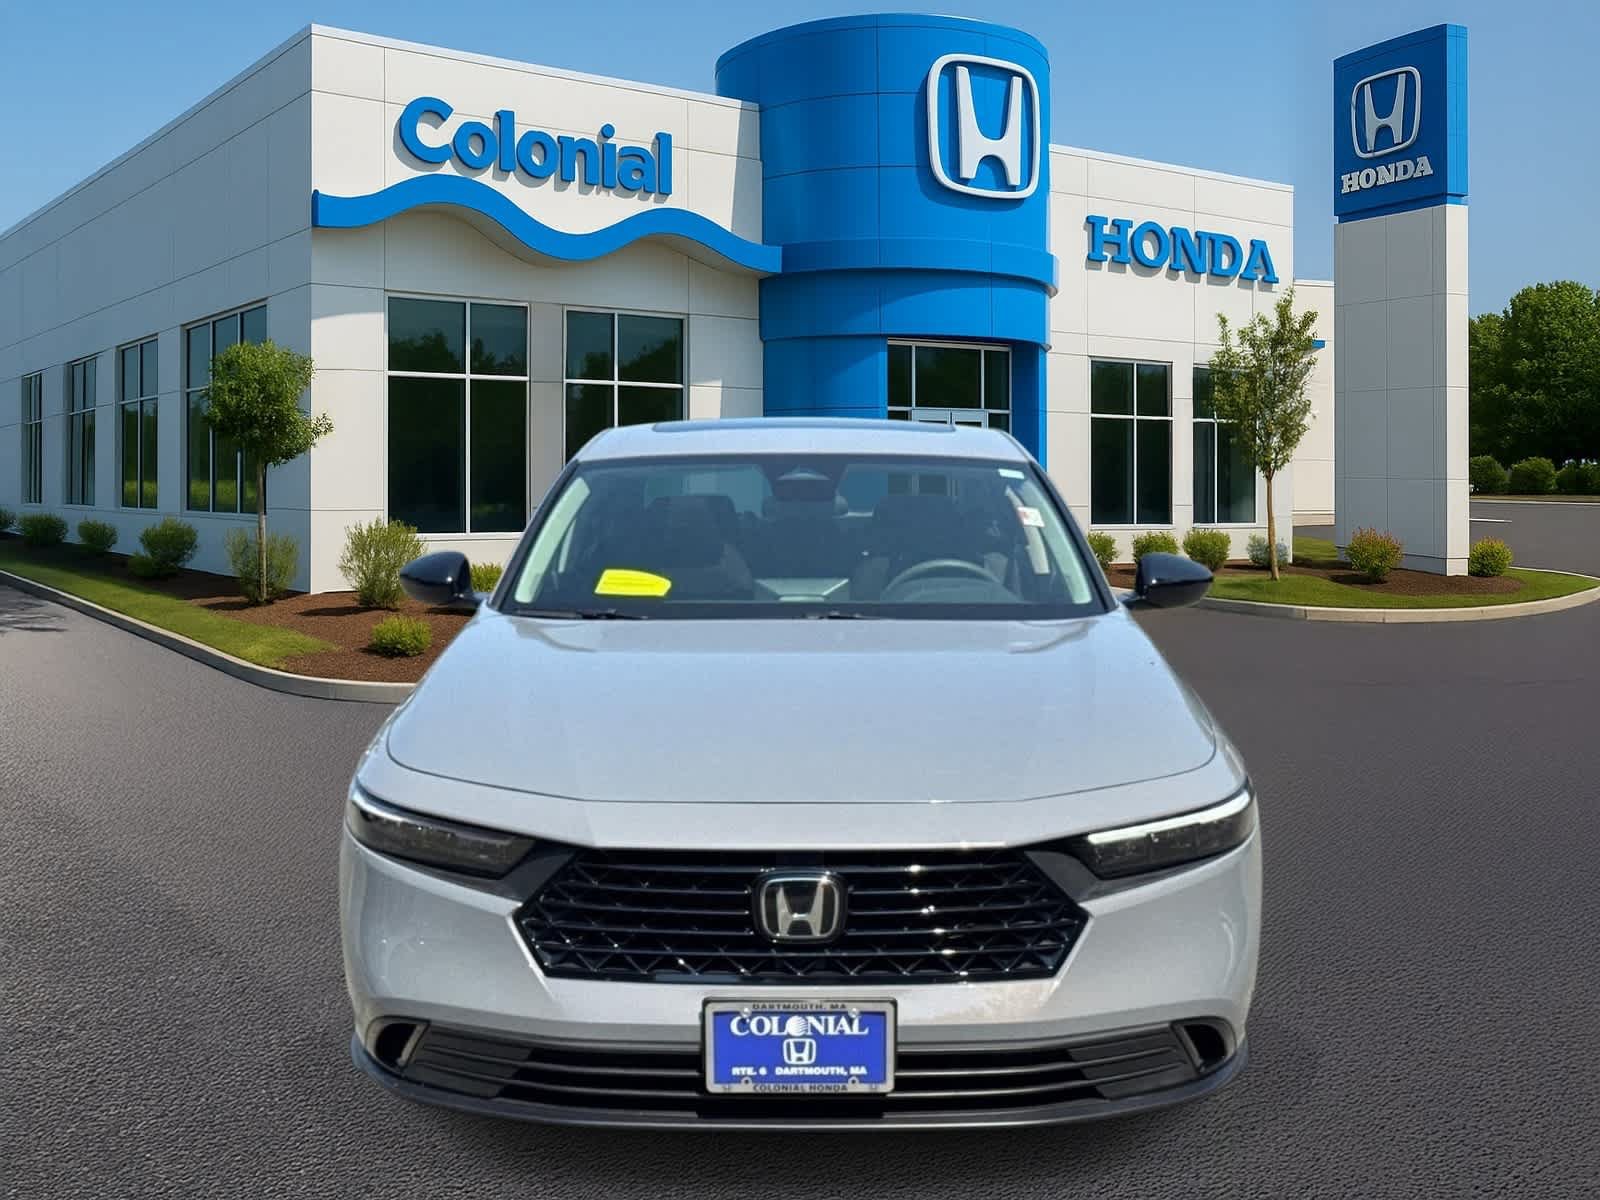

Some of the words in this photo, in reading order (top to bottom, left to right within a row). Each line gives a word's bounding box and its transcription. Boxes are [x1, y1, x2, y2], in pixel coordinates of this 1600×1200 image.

[399, 96, 672, 194] Colonial
[1341, 156, 1432, 194] HONDA
[1086, 215, 1279, 283] HONDA
[730, 1015, 869, 1037] COLONIAL
[759, 1067, 767, 1075] 6
[850, 1067, 867, 1075] MA
[753, 1084, 805, 1092] COLONIAL
[809, 1084, 848, 1092] HONDA
